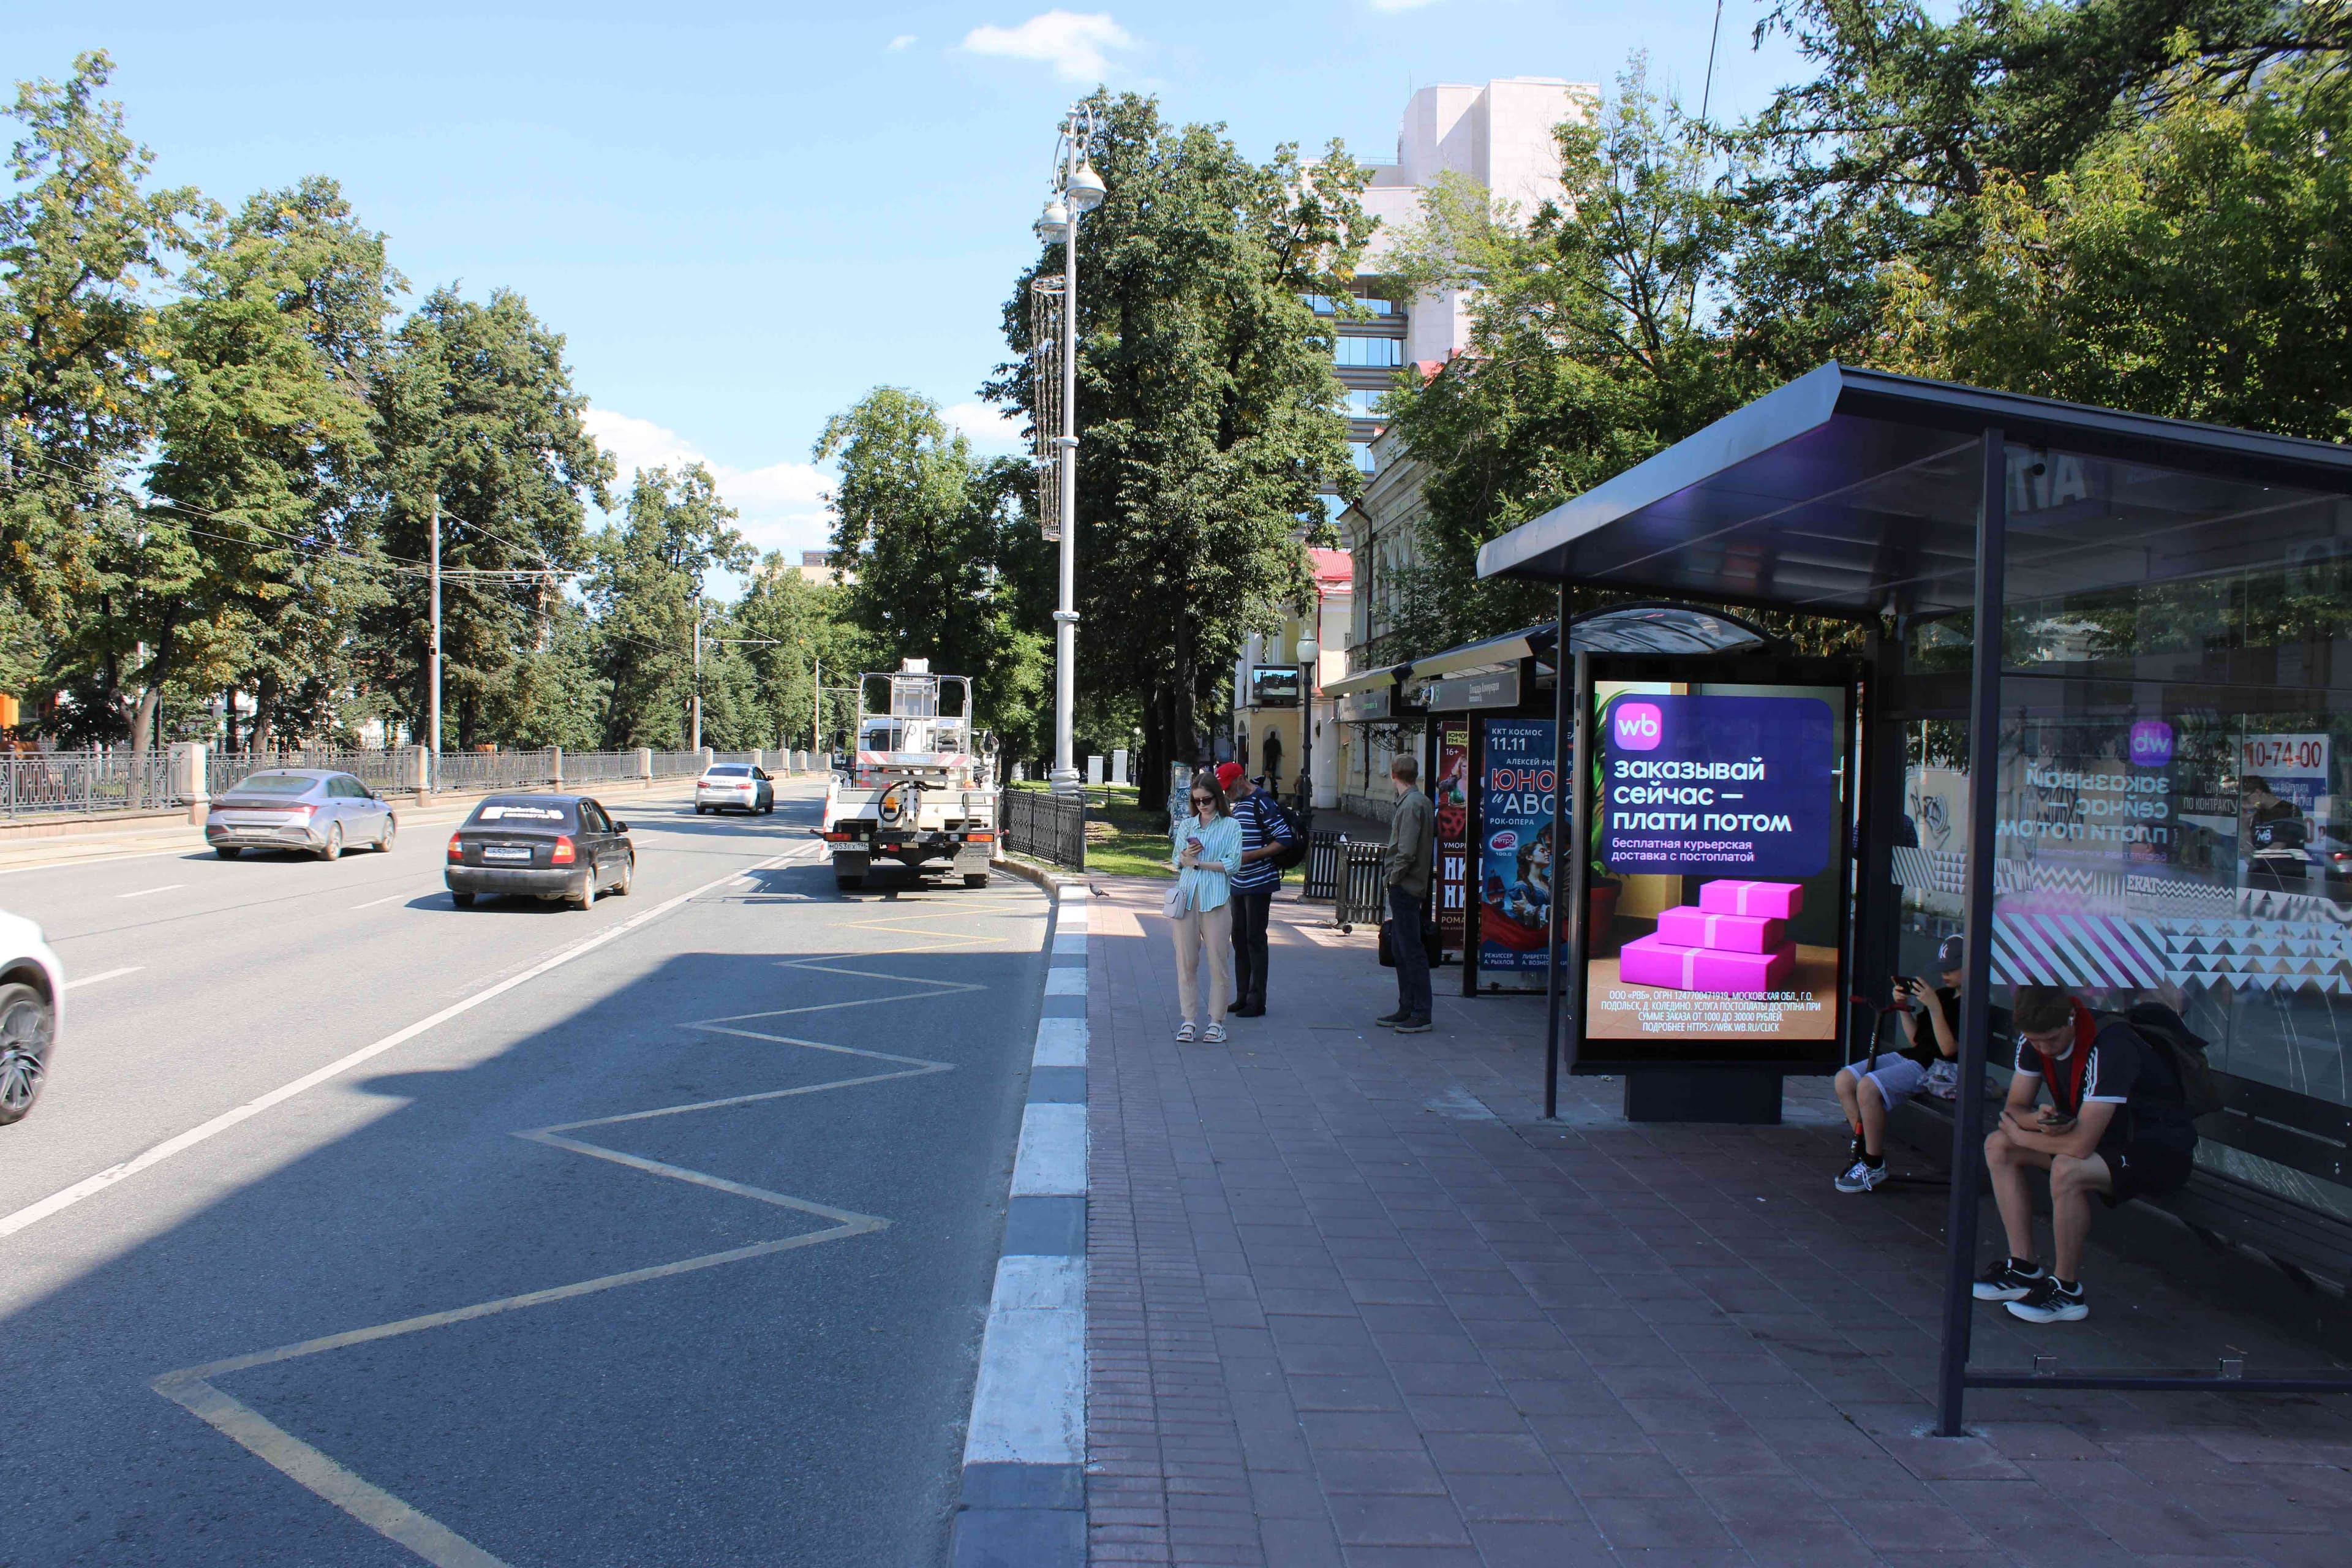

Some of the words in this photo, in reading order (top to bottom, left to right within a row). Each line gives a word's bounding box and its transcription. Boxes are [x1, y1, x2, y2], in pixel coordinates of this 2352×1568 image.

[1618, 712, 1658, 737] wb
[1491, 737, 1526, 751] 11.11
[1506, 757, 1540, 766] АЛЕКСЕЙ
[1614, 756, 1765, 780] заказывай
[1613, 781, 1714, 805] сейчас
[2183, 797, 2194, 810] ПО
[2195, 797, 2239, 814] КОНТРАКТУ
[1613, 812, 1697, 832] плати
[1703, 814, 1793, 833] потом
[1611, 837, 1681, 849] бесплатная
[1683, 840, 1752, 853] курьерская
[1611, 851, 1667, 862] доставка
[1679, 851, 1755, 862] постоплатой
[1609, 990, 1626, 1000] ООО
[1654, 991, 1672, 1000] ОГРН
[1732, 992, 1779, 1001] МОСКОВСКАЯ
[1781, 992, 1799, 1002] ОБЛ.,
[1801, 992, 1814, 1001] Г.О.
[1601, 1001, 1642, 1012] ПОДОЛЬСК,
[1652, 1001, 1692, 1012] КОЛЕДИНО.
[1694, 1002, 1719, 1011] УСЛУГА
[1720, 1002, 1768, 1011] ПОСТОПЛАТЫ
[1768, 1002, 1804, 1012] ДОСТУПНА
[1806, 1002, 1821, 1011] ПРИ
[1638, 1012, 1664, 1021] СУММЕ
[1665, 1012, 1691, 1021] ЗАКАЗА
[1692, 1012, 1702, 1021] ОТ
[1704, 1012, 1720, 1021] 1000
[1721, 1012, 1732, 1023] ДО
[1734, 1012, 1754, 1021] 30000
[1756, 1011, 1784, 1022] РУБЛЕЙ.
[1643, 1022, 1685, 1033] ПОДРОБНЕЕ
